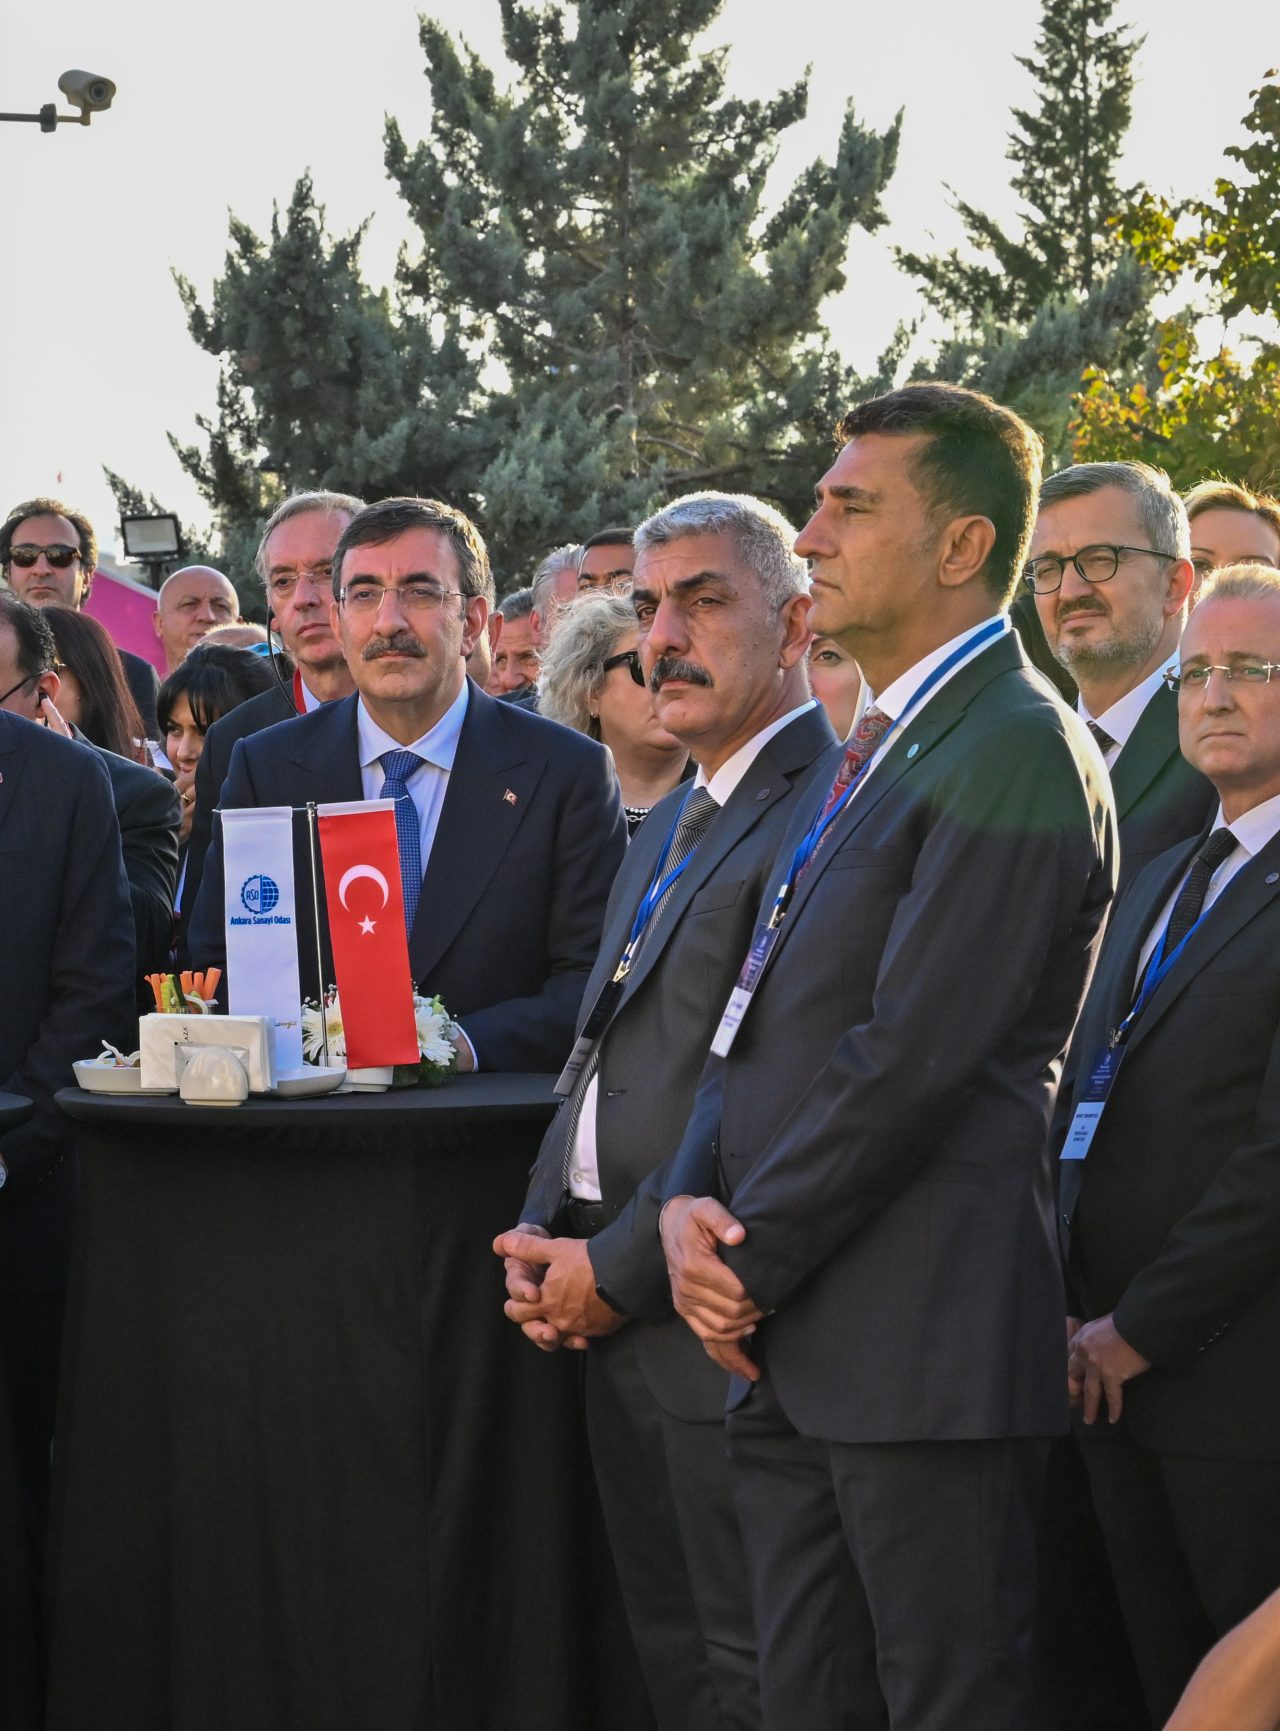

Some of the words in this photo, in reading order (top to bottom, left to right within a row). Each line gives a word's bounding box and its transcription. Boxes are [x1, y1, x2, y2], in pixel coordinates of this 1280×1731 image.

[246, 889, 259, 901] ASO
[231, 916, 251, 925] Ankara
[253, 916, 273, 926] Sanayi
[274, 915, 291, 925] Odası
